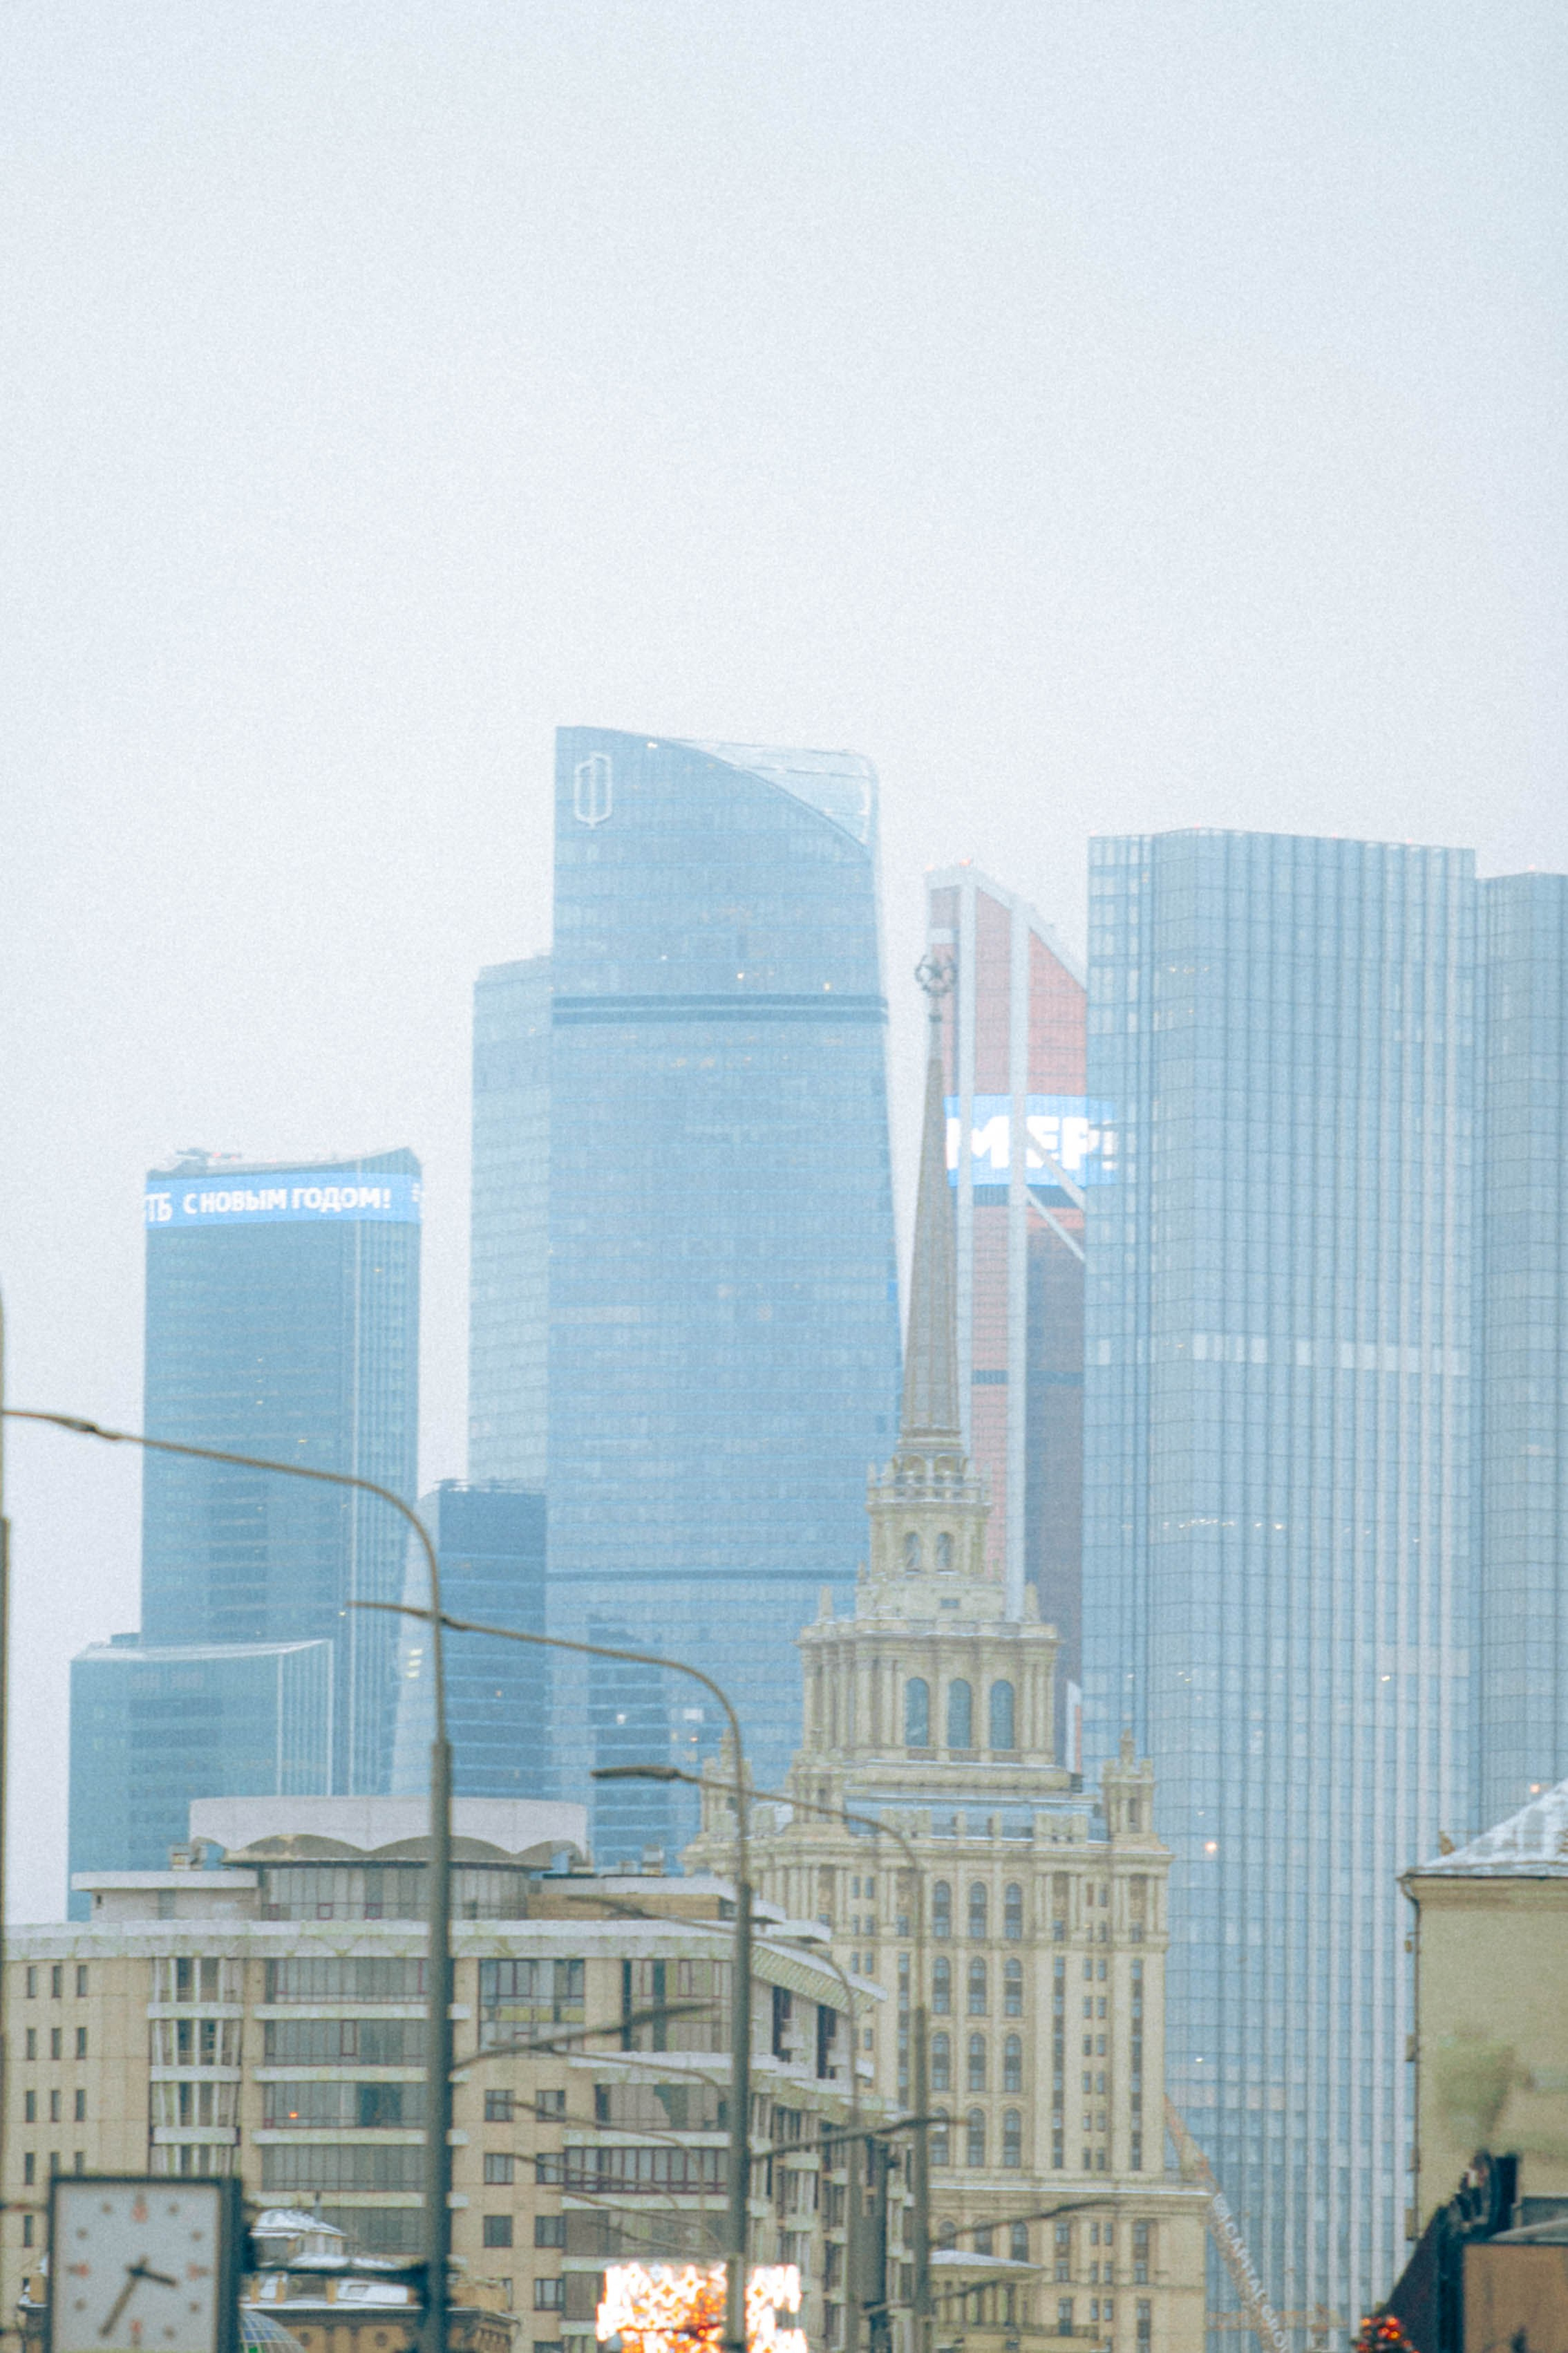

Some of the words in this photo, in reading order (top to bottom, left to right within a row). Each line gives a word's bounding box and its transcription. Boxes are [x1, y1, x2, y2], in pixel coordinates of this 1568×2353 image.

[182, 1193, 197, 1215] С
[200, 1188, 287, 1213] НОВЫМ
[292, 1187, 391, 1212] ГОДОМ!
